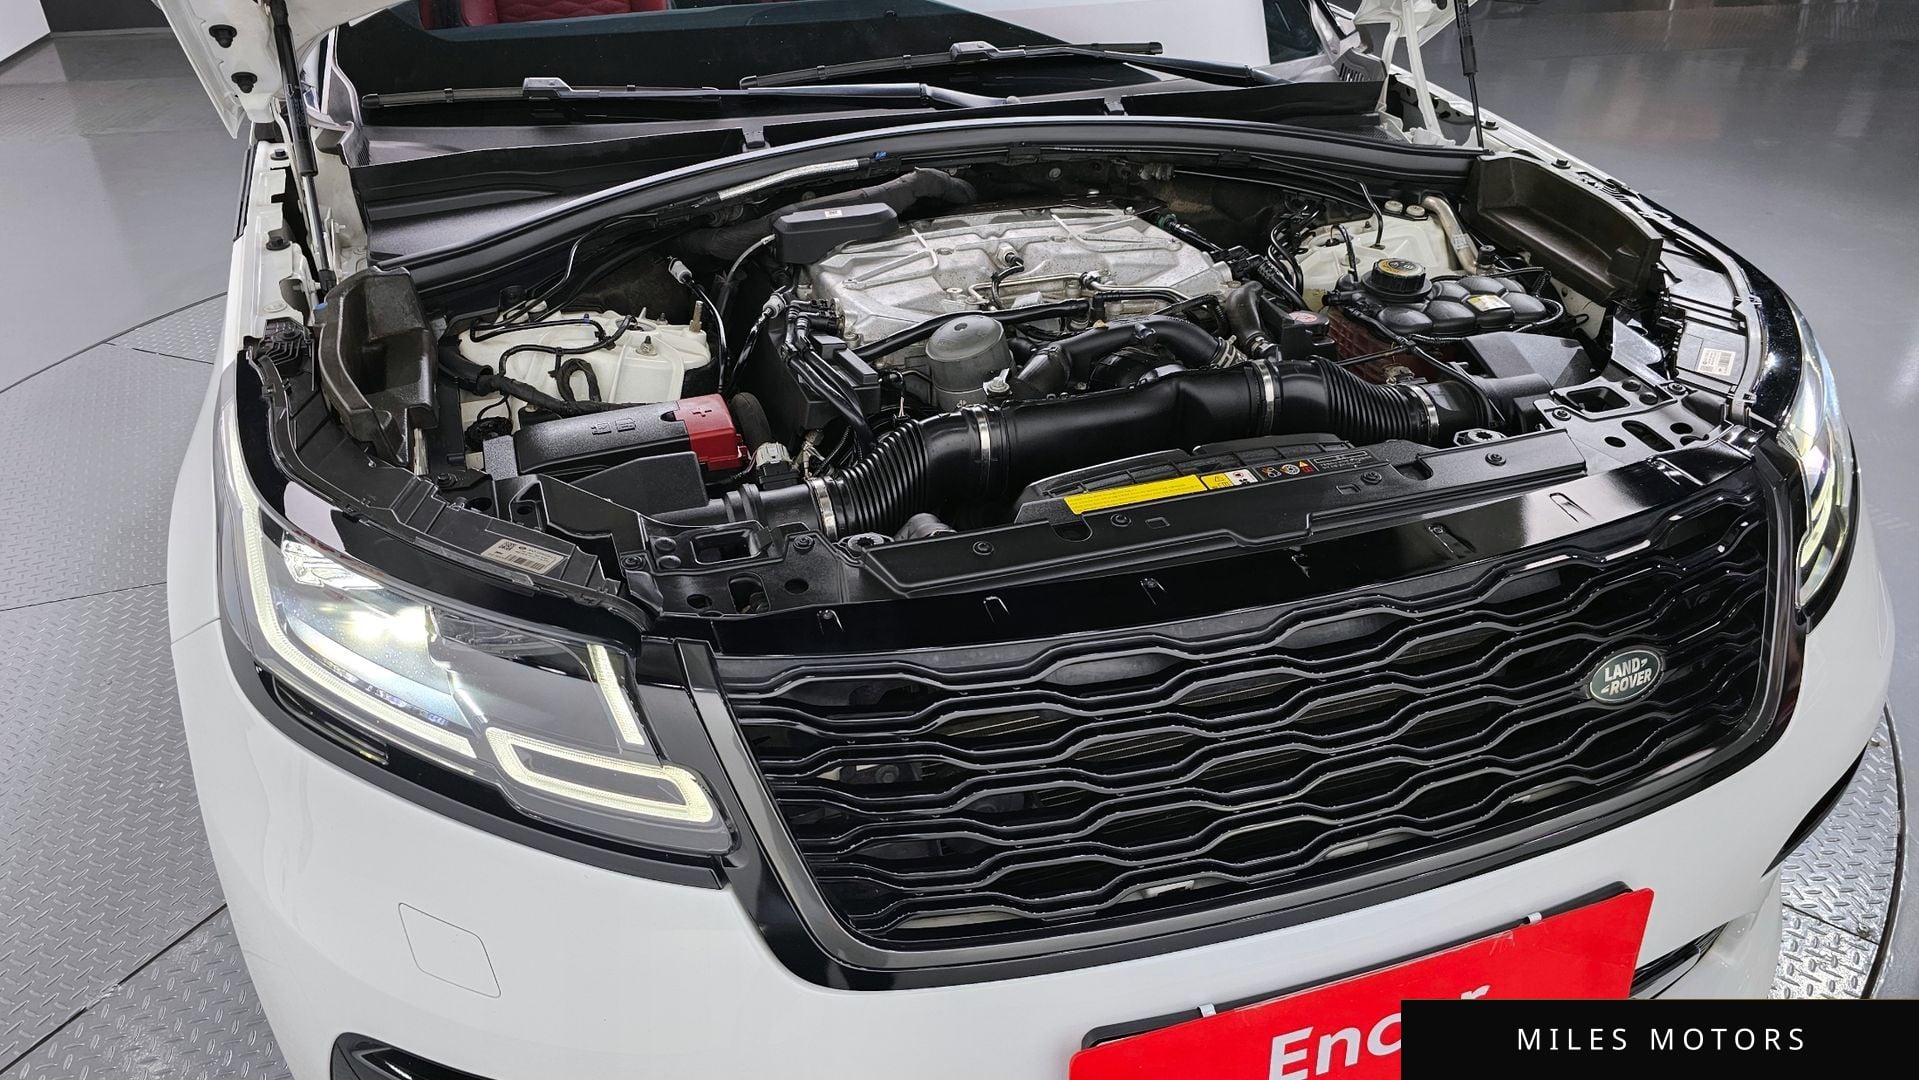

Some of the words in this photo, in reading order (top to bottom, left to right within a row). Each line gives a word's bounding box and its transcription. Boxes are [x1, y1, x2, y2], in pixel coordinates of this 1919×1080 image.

[1604, 657, 1640, 683] LAND
[1609, 668, 1652, 696] ROVER
[1269, 984, 1491, 1080] Enc
